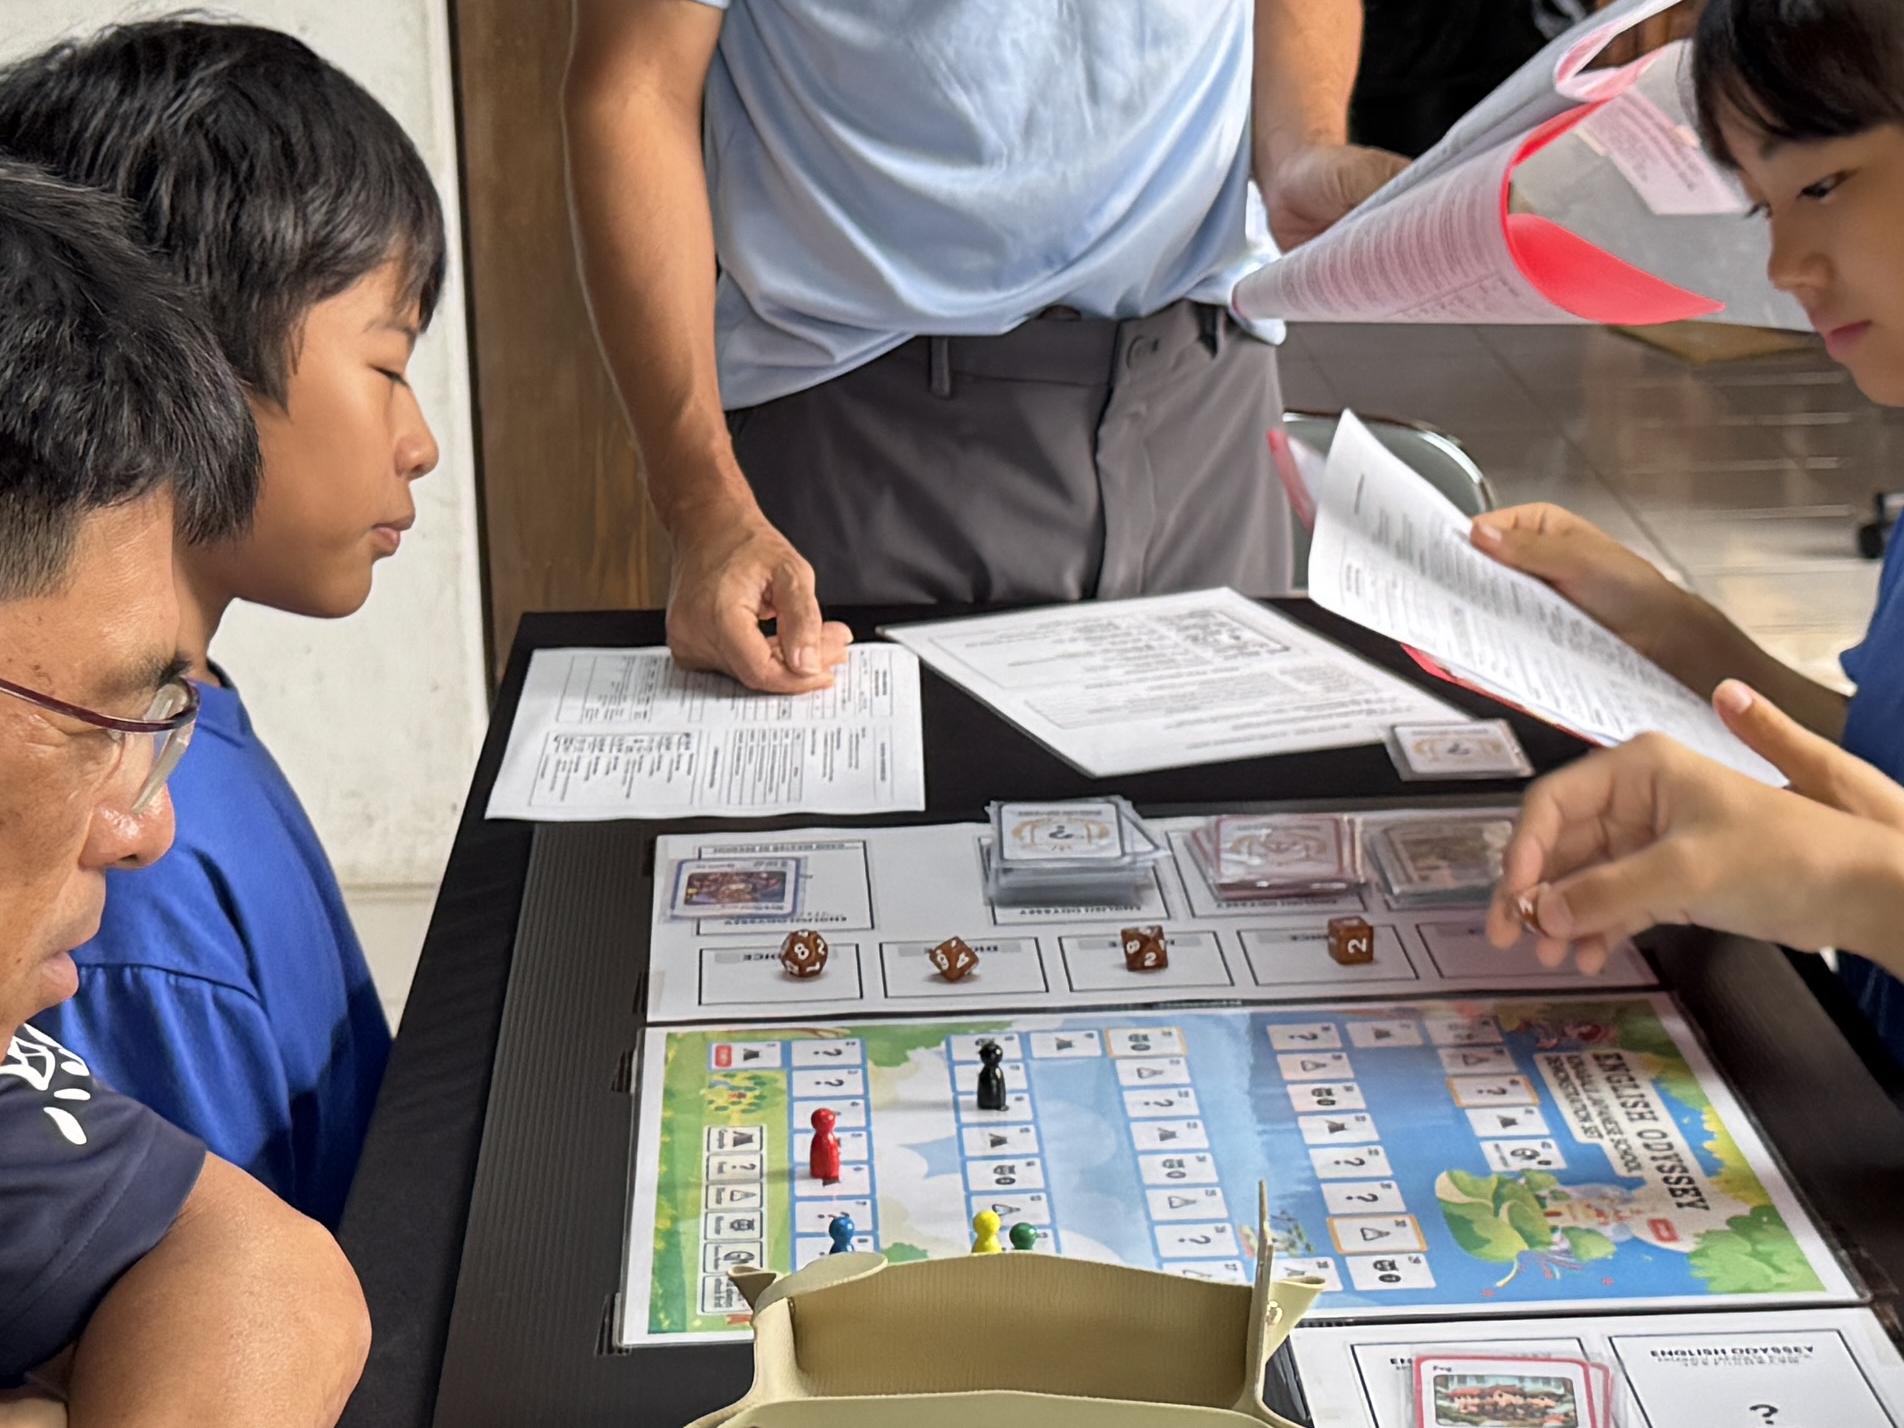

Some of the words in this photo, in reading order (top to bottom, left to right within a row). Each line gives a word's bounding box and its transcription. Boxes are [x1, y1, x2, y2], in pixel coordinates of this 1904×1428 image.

[794, 943, 809, 960] 8
[1347, 938, 1367, 953] 2
[1590, 1050, 1659, 1124] ENGLISH
[1634, 1127, 1711, 1213] ODYSSEY
[1731, 1346, 1815, 1356] ODYSSEY
